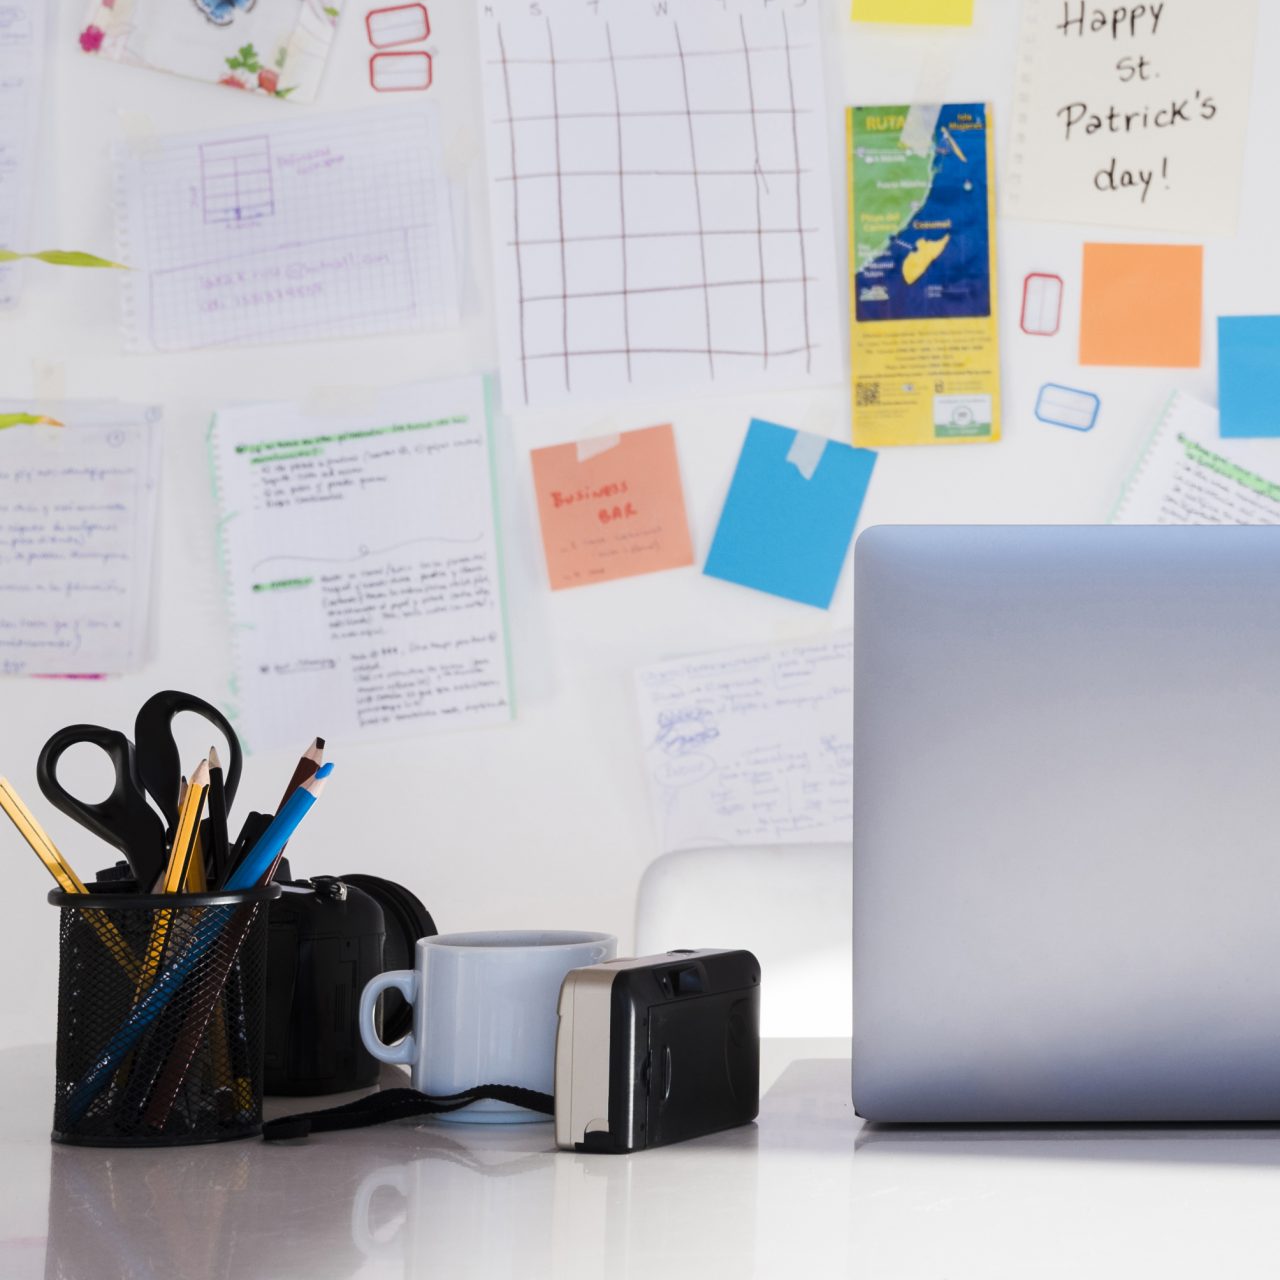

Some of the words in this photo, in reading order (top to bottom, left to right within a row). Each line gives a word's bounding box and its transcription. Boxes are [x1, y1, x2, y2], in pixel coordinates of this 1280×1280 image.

[1056, 0, 1165, 39] Happy
[1057, 89, 1218, 141] Patrick's
[1093, 158, 1171, 203] day!
